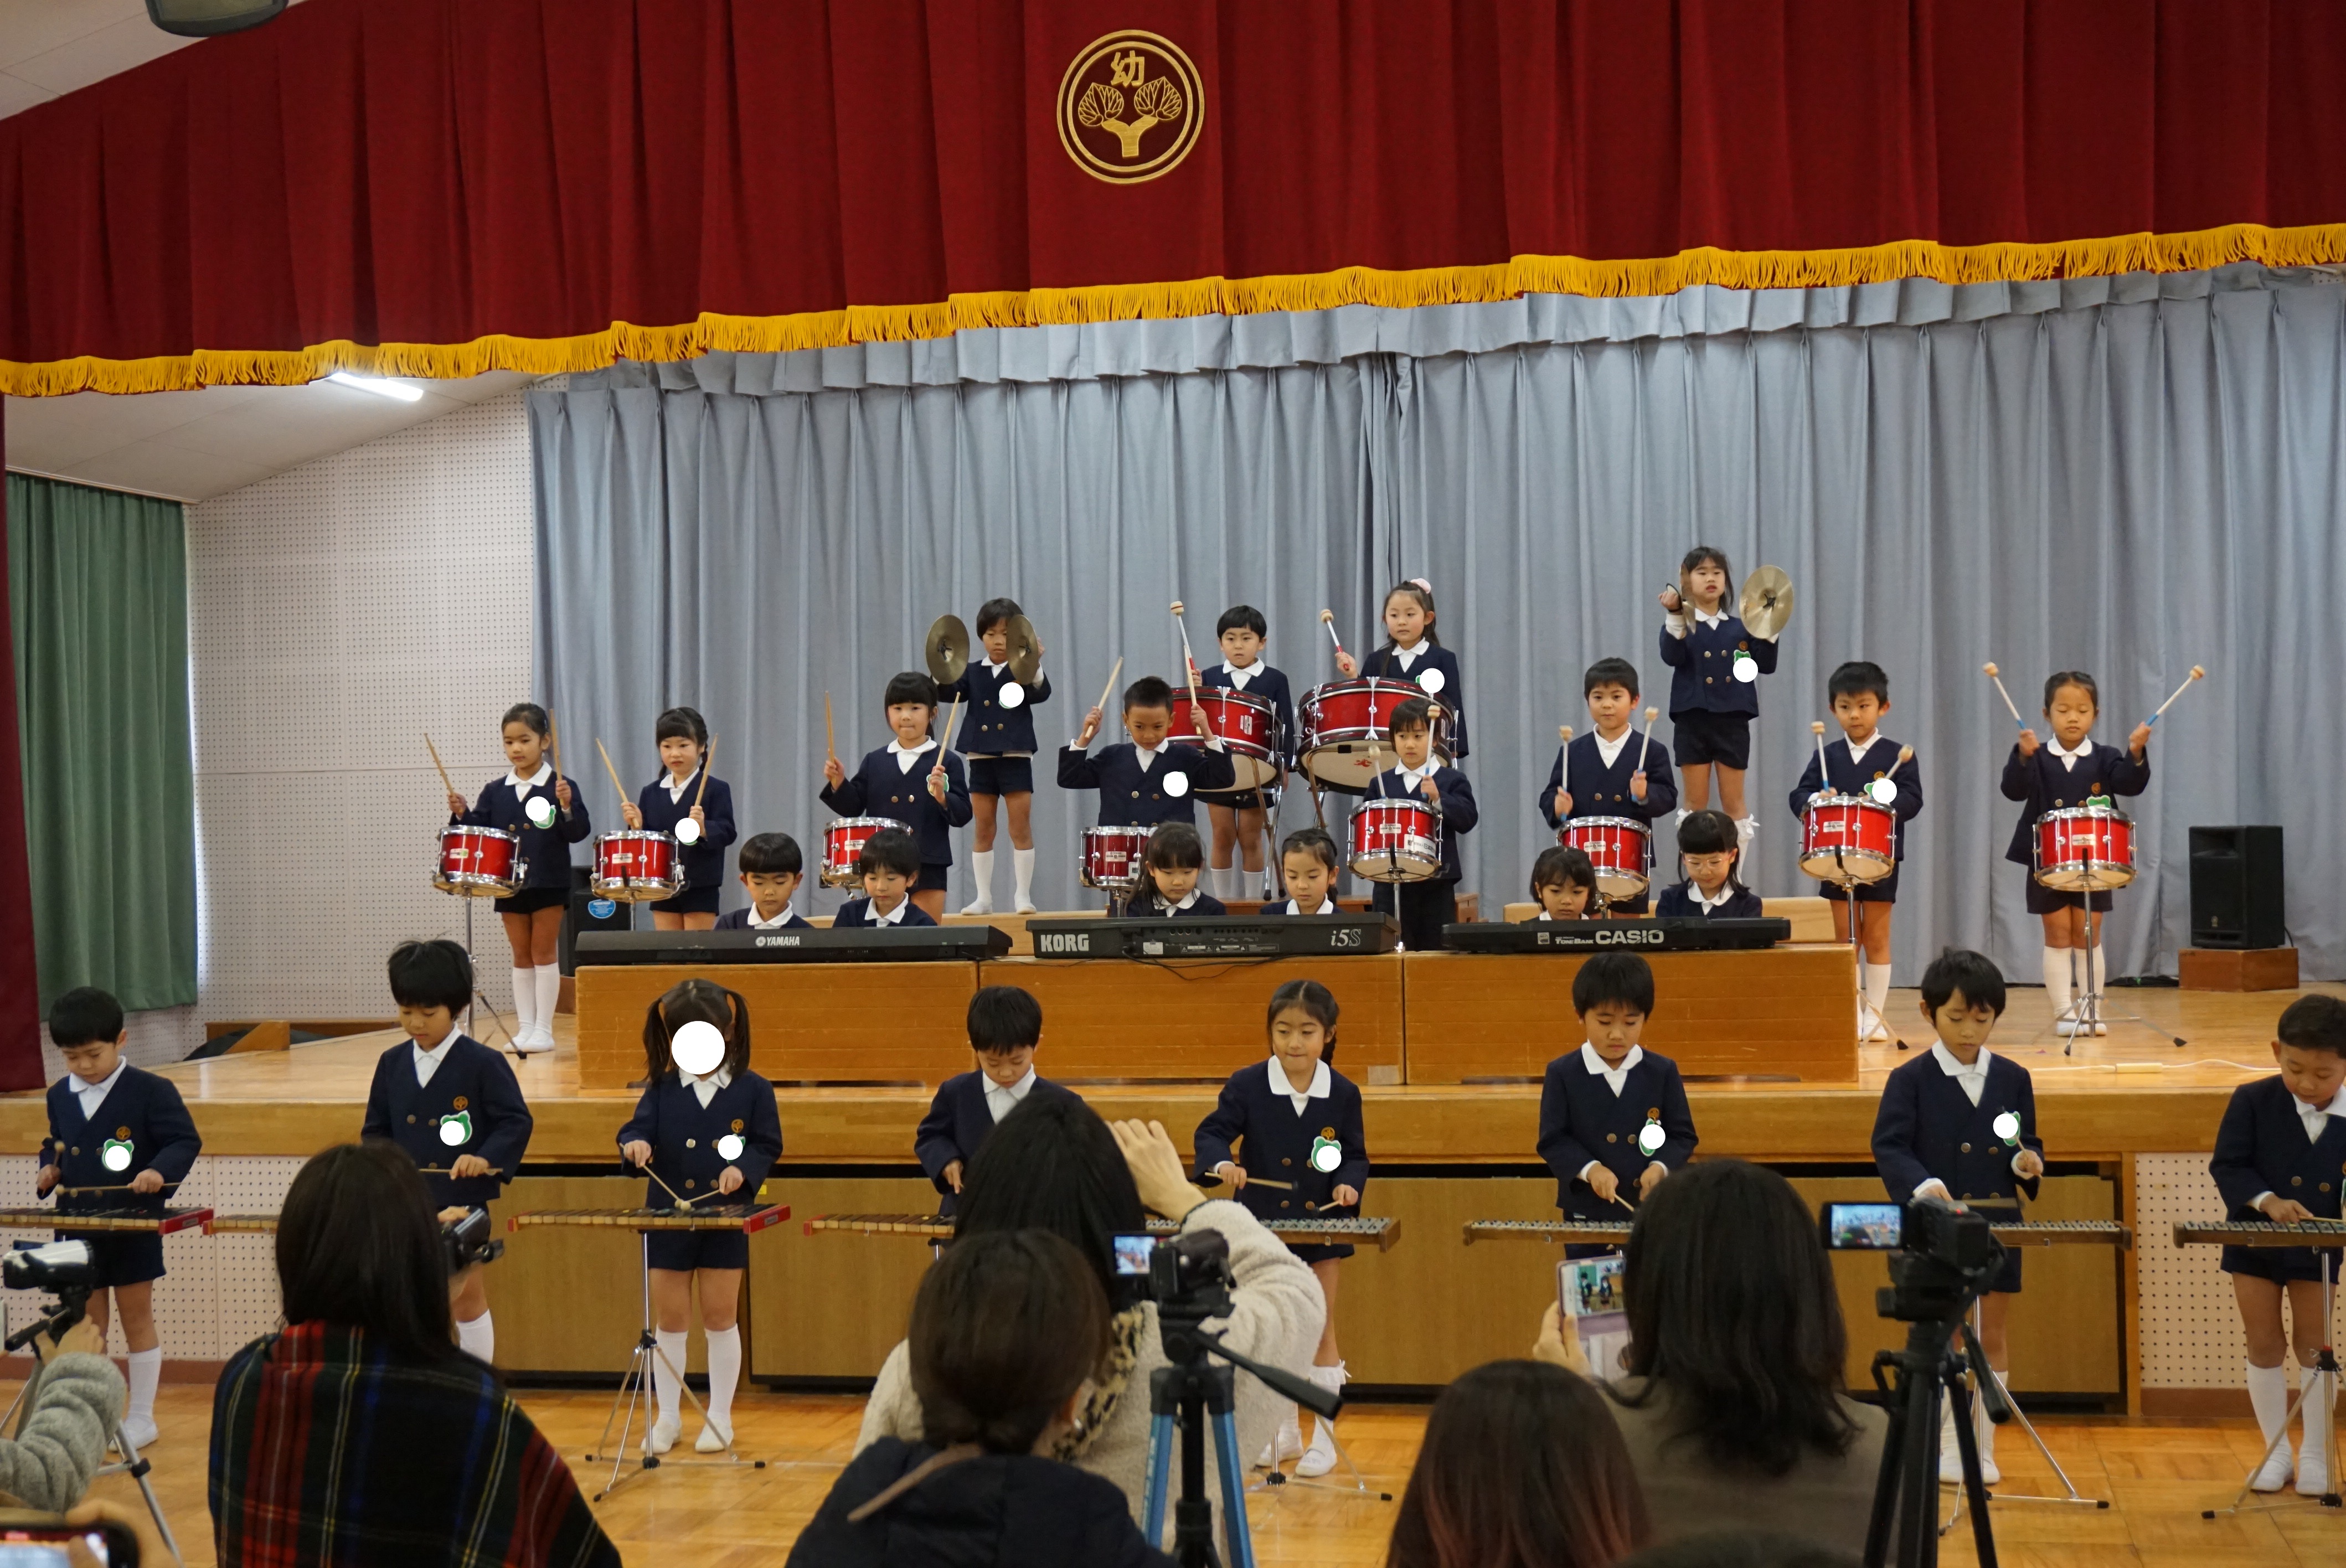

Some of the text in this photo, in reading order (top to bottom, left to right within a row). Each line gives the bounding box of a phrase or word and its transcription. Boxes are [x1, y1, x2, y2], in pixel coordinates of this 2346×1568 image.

[1110, 50, 1145, 87] 幼
[766, 936, 800, 946] YAMAHA
[1040, 933, 1089, 952] KORG
[1331, 929, 1362, 946] i5S
[1595, 930, 1664, 945] CASIO
